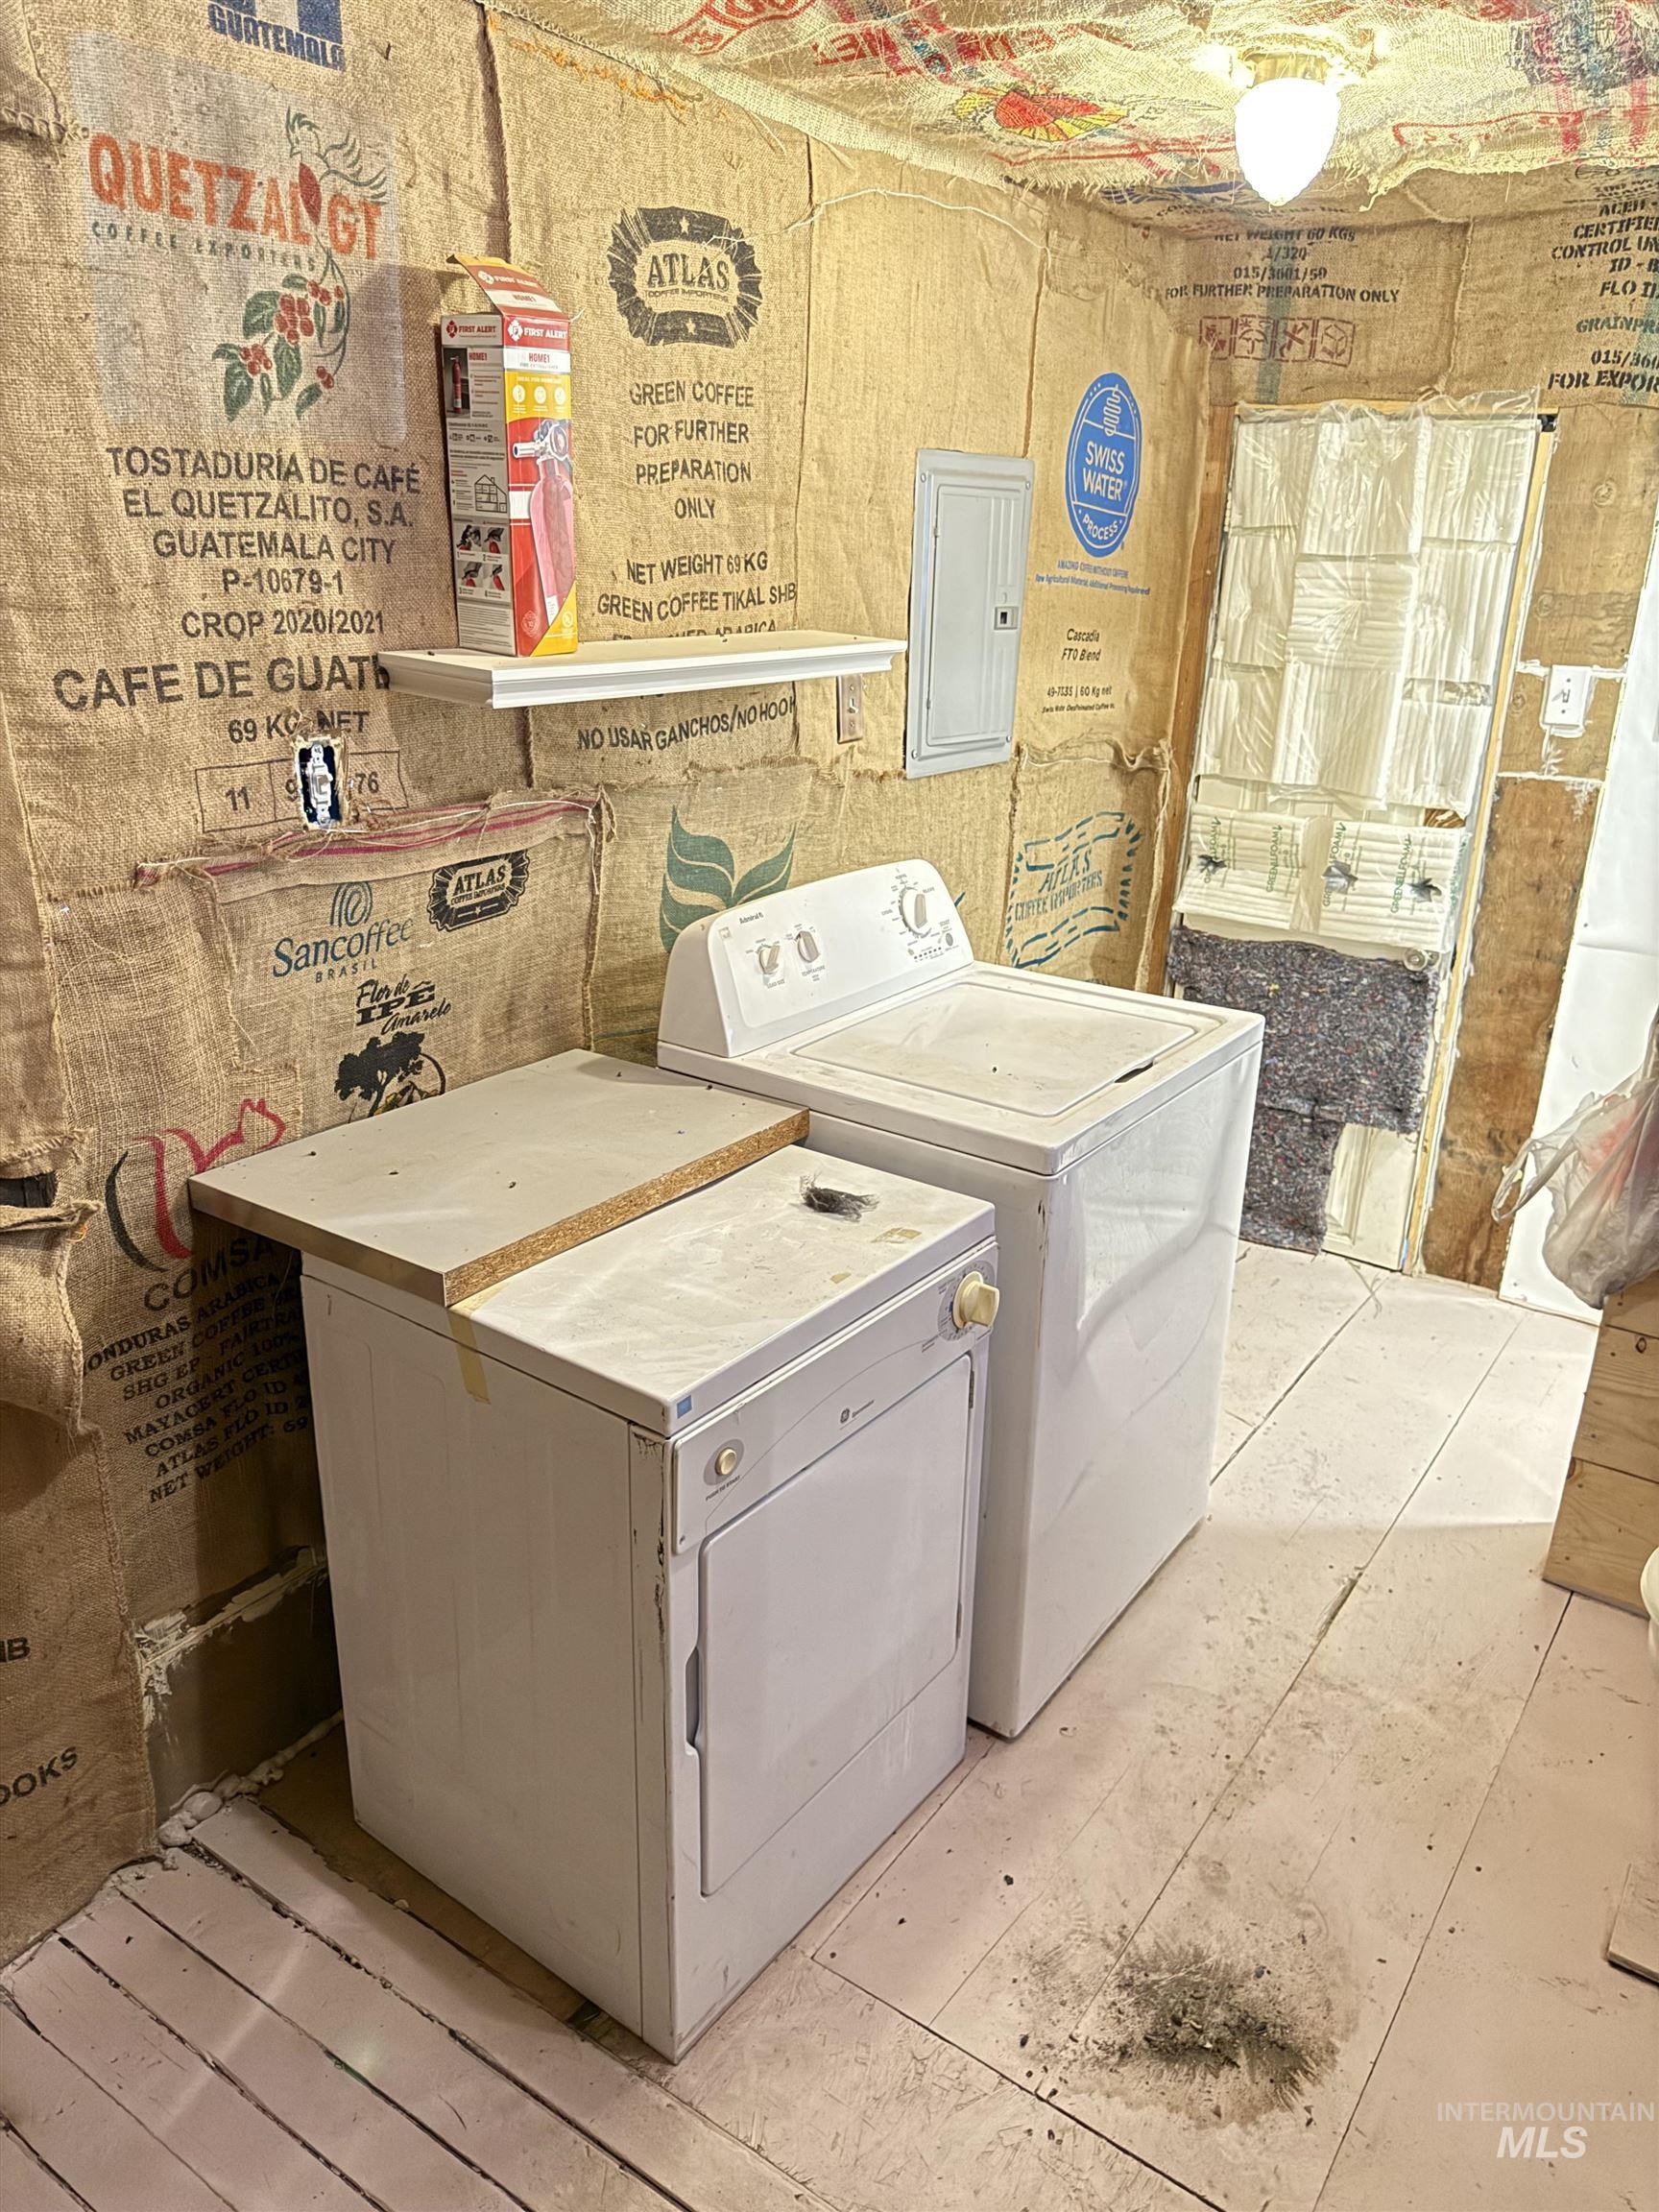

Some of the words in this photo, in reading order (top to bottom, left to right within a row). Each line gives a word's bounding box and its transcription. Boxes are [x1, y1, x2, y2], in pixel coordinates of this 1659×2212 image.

[87, 132, 313, 246] QUETZAL
[326, 192, 383, 260] GT
[91, 221, 179, 250] COFFEE
[194, 239, 317, 273] EXPORTERS
[1551, 237, 1632, 260] CONTROL
[648, 252, 730, 292] ATLAS
[1599, 280, 1637, 298] FLO
[1192, 283, 1253, 298] FURTHER
[1257, 284, 1356, 302] PREPARATION
[1359, 289, 1400, 302] ONLY
[524, 326, 544, 337] FIRST
[545, 328, 568, 340] ALERT
[469, 351, 488, 362] HOME1
[528, 352, 551, 364] HOME1
[629, 380, 686, 406] GREEN
[691, 380, 755, 408] COFFEE
[1548, 372, 1591, 391] FOR
[634, 422, 670, 448] FOR
[674, 419, 750, 444] FURTHER
[106, 445, 301, 482] TOSTADURÍA
[309, 456, 347, 488] DE
[353, 462, 422, 495] CAFÉ
[636, 458, 752, 486] PREPARATION
[1085, 440, 1125, 475] SWISS
[1082, 467, 1123, 502] WATER
[122, 488, 162, 519] EL
[170, 489, 361, 529] QUETZALITO,
[366, 499, 415, 528] S.A.
[674, 496, 716, 519] ONLY
[1082, 513, 1118, 541] PROCESS
[152, 530, 335, 565] GUATEMALA
[340, 537, 397, 565] CITY
[221, 567, 345, 596] P-10679-1
[626, 559, 657, 585] NET
[661, 553, 723, 577] WEIGHT
[726, 554, 741, 574] 69
[743, 550, 768, 572] KG
[597, 592, 653, 622] GREEN
[657, 590, 719, 621] COFFEE
[722, 586, 765, 612] TIKAL
[769, 582, 798, 605] SHB
[180, 610, 266, 643] CROP
[273, 608, 386, 637] 2020/2021
[1067, 628, 1100, 642] Cascadia
[1078, 648, 1102, 661] Blend
[52, 661, 185, 713] CAFE
[193, 659, 253, 701] DE
[1080, 685, 1091, 697] 60
[1091, 685, 1101, 698] Kg
[1101, 685, 1113, 696] net
[228, 717, 259, 745] 69
[578, 727, 605, 751] NO
[608, 726, 654, 752] USAR
[451, 892, 473, 905] COFFEE
[452, 864, 507, 899] ATLAS
[273, 917, 414, 978] Sancoffee
[315, 958, 378, 984] BRASIL
[355, 980, 436, 1027] IPÊ
[356, 978, 392, 1008] Flor
[394, 973, 411, 996] de
[144, 1235, 276, 1312] COMSA
[195, 1269, 278, 1324] ARABICA
[109, 1340, 185, 1382] GREEN
[190, 1297, 266, 1348] COFFEE
[122, 1371, 169, 1401] SHG
[156, 1351, 248, 1410] ORGANIC
[123, 1379, 235, 1445] MAYACERT
[144, 1415, 217, 1457] COMSA
[221, 1387, 256, 1418] FLO
[263, 1380, 287, 1396] ID
[156, 1438, 220, 1479] ATLAS
[223, 1408, 258, 1441] FLO
[266, 1400, 288, 1415] ID
[149, 1472, 189, 1503] NET
[195, 1421, 276, 1480] WEIGHT:
[282, 1416, 309, 1433] 69
